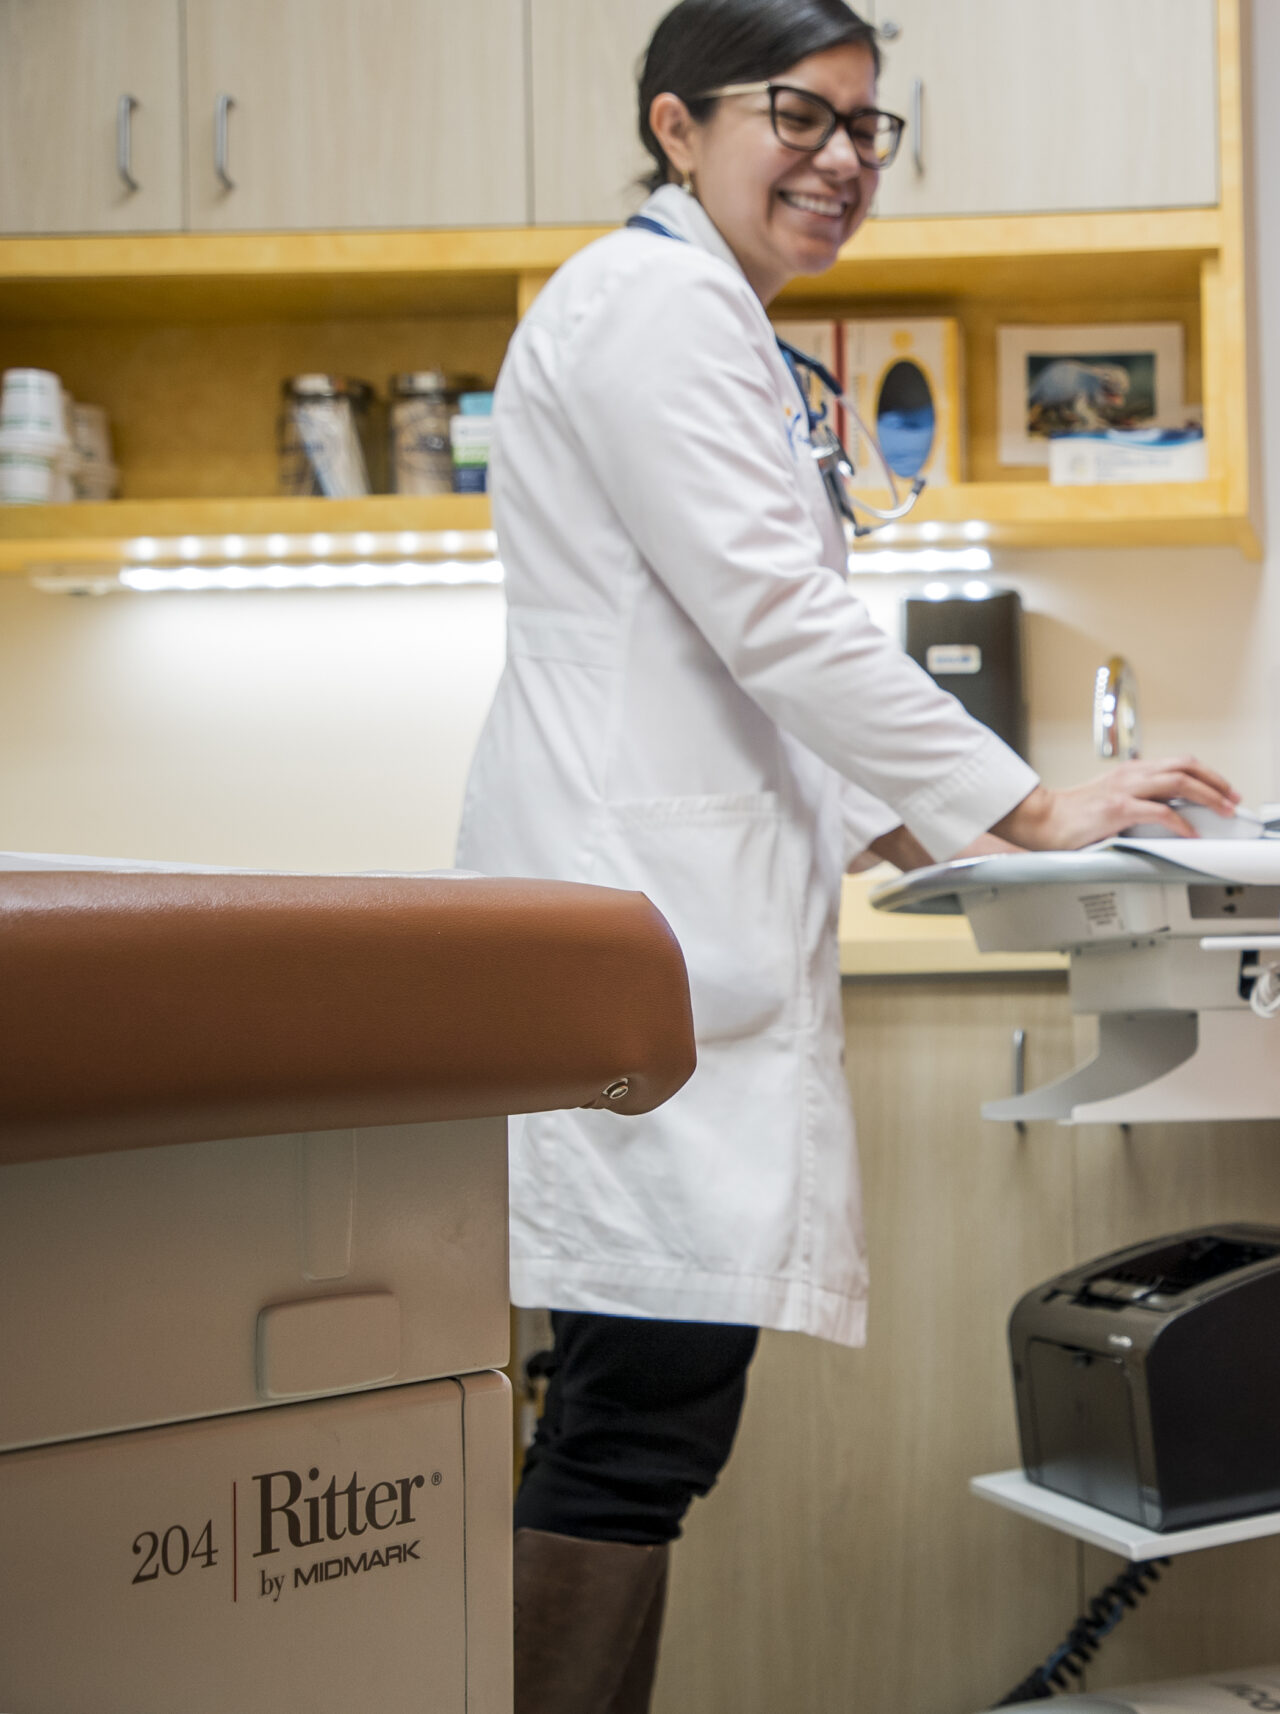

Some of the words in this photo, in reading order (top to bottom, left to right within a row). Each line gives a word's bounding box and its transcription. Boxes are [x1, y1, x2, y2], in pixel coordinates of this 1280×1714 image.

[132, 1519, 218, 1585] 204
[260, 1568, 286, 1602] by
[294, 1539, 421, 1589] MIDMARK
